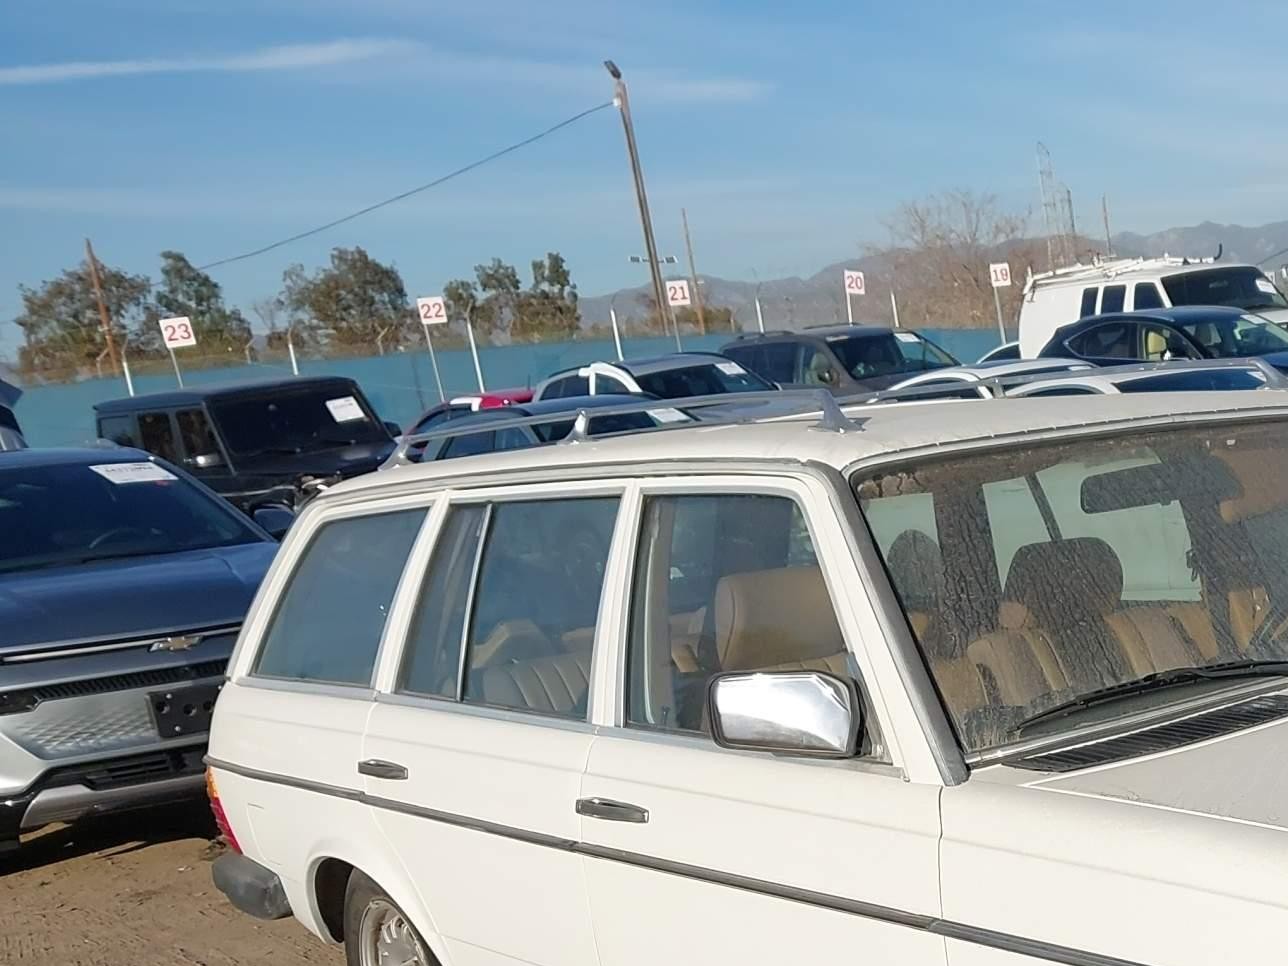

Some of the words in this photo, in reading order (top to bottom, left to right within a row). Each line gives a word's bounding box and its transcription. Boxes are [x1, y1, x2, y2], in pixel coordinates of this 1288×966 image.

[847, 275, 863, 290] 20
[669, 286, 688, 301] 21
[421, 302, 444, 319] 22
[164, 323, 192, 341] 23
